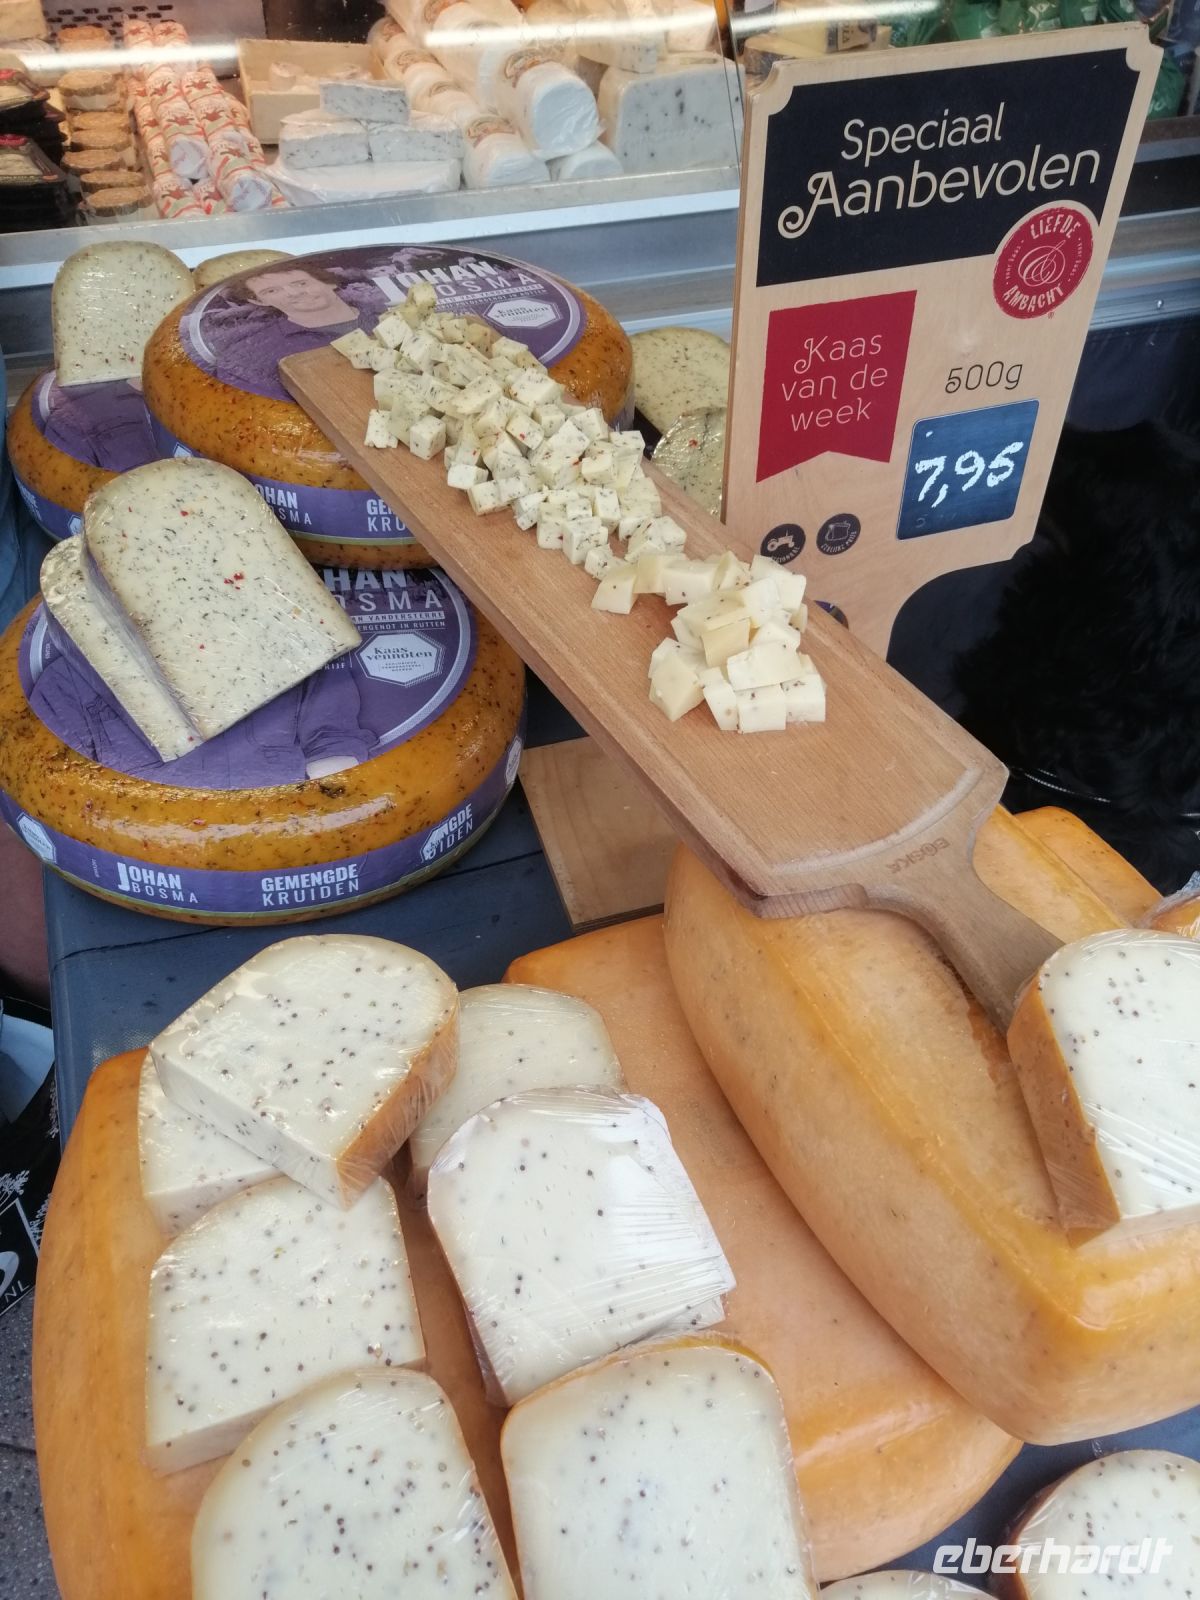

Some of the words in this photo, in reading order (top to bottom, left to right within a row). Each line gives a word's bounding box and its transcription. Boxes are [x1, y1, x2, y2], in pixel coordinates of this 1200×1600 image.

[841, 102, 1004, 168] Speciaal
[777, 144, 1101, 239] Aanbevolen
[1030, 213, 1082, 240] LIEFDE
[438, 272, 537, 297] OSMA
[1003, 283, 1064, 312] AMBACHT
[793, 334, 883, 375] Kaas
[781, 375, 837, 401] van
[850, 364, 888, 391] de
[945, 360, 1023, 394] 500g
[791, 397, 872, 432] week
[915, 441, 1024, 508] 7,95
[366, 499, 394, 516] GE
[323, 568, 408, 592] HAN
[357, 623, 396, 631] ERGENOT
[413, 621, 446, 629] RUTTEN
[369, 612, 444, 621] VANDERSTERRE
[366, 651, 433, 661] vennoten
[374, 647, 409, 655] Kaas
[117, 862, 183, 892] JOHAN
[261, 863, 359, 892] GEMENGDE
[131, 881, 199, 904] BOSMA
[262, 878, 359, 907] KRUIDEN
